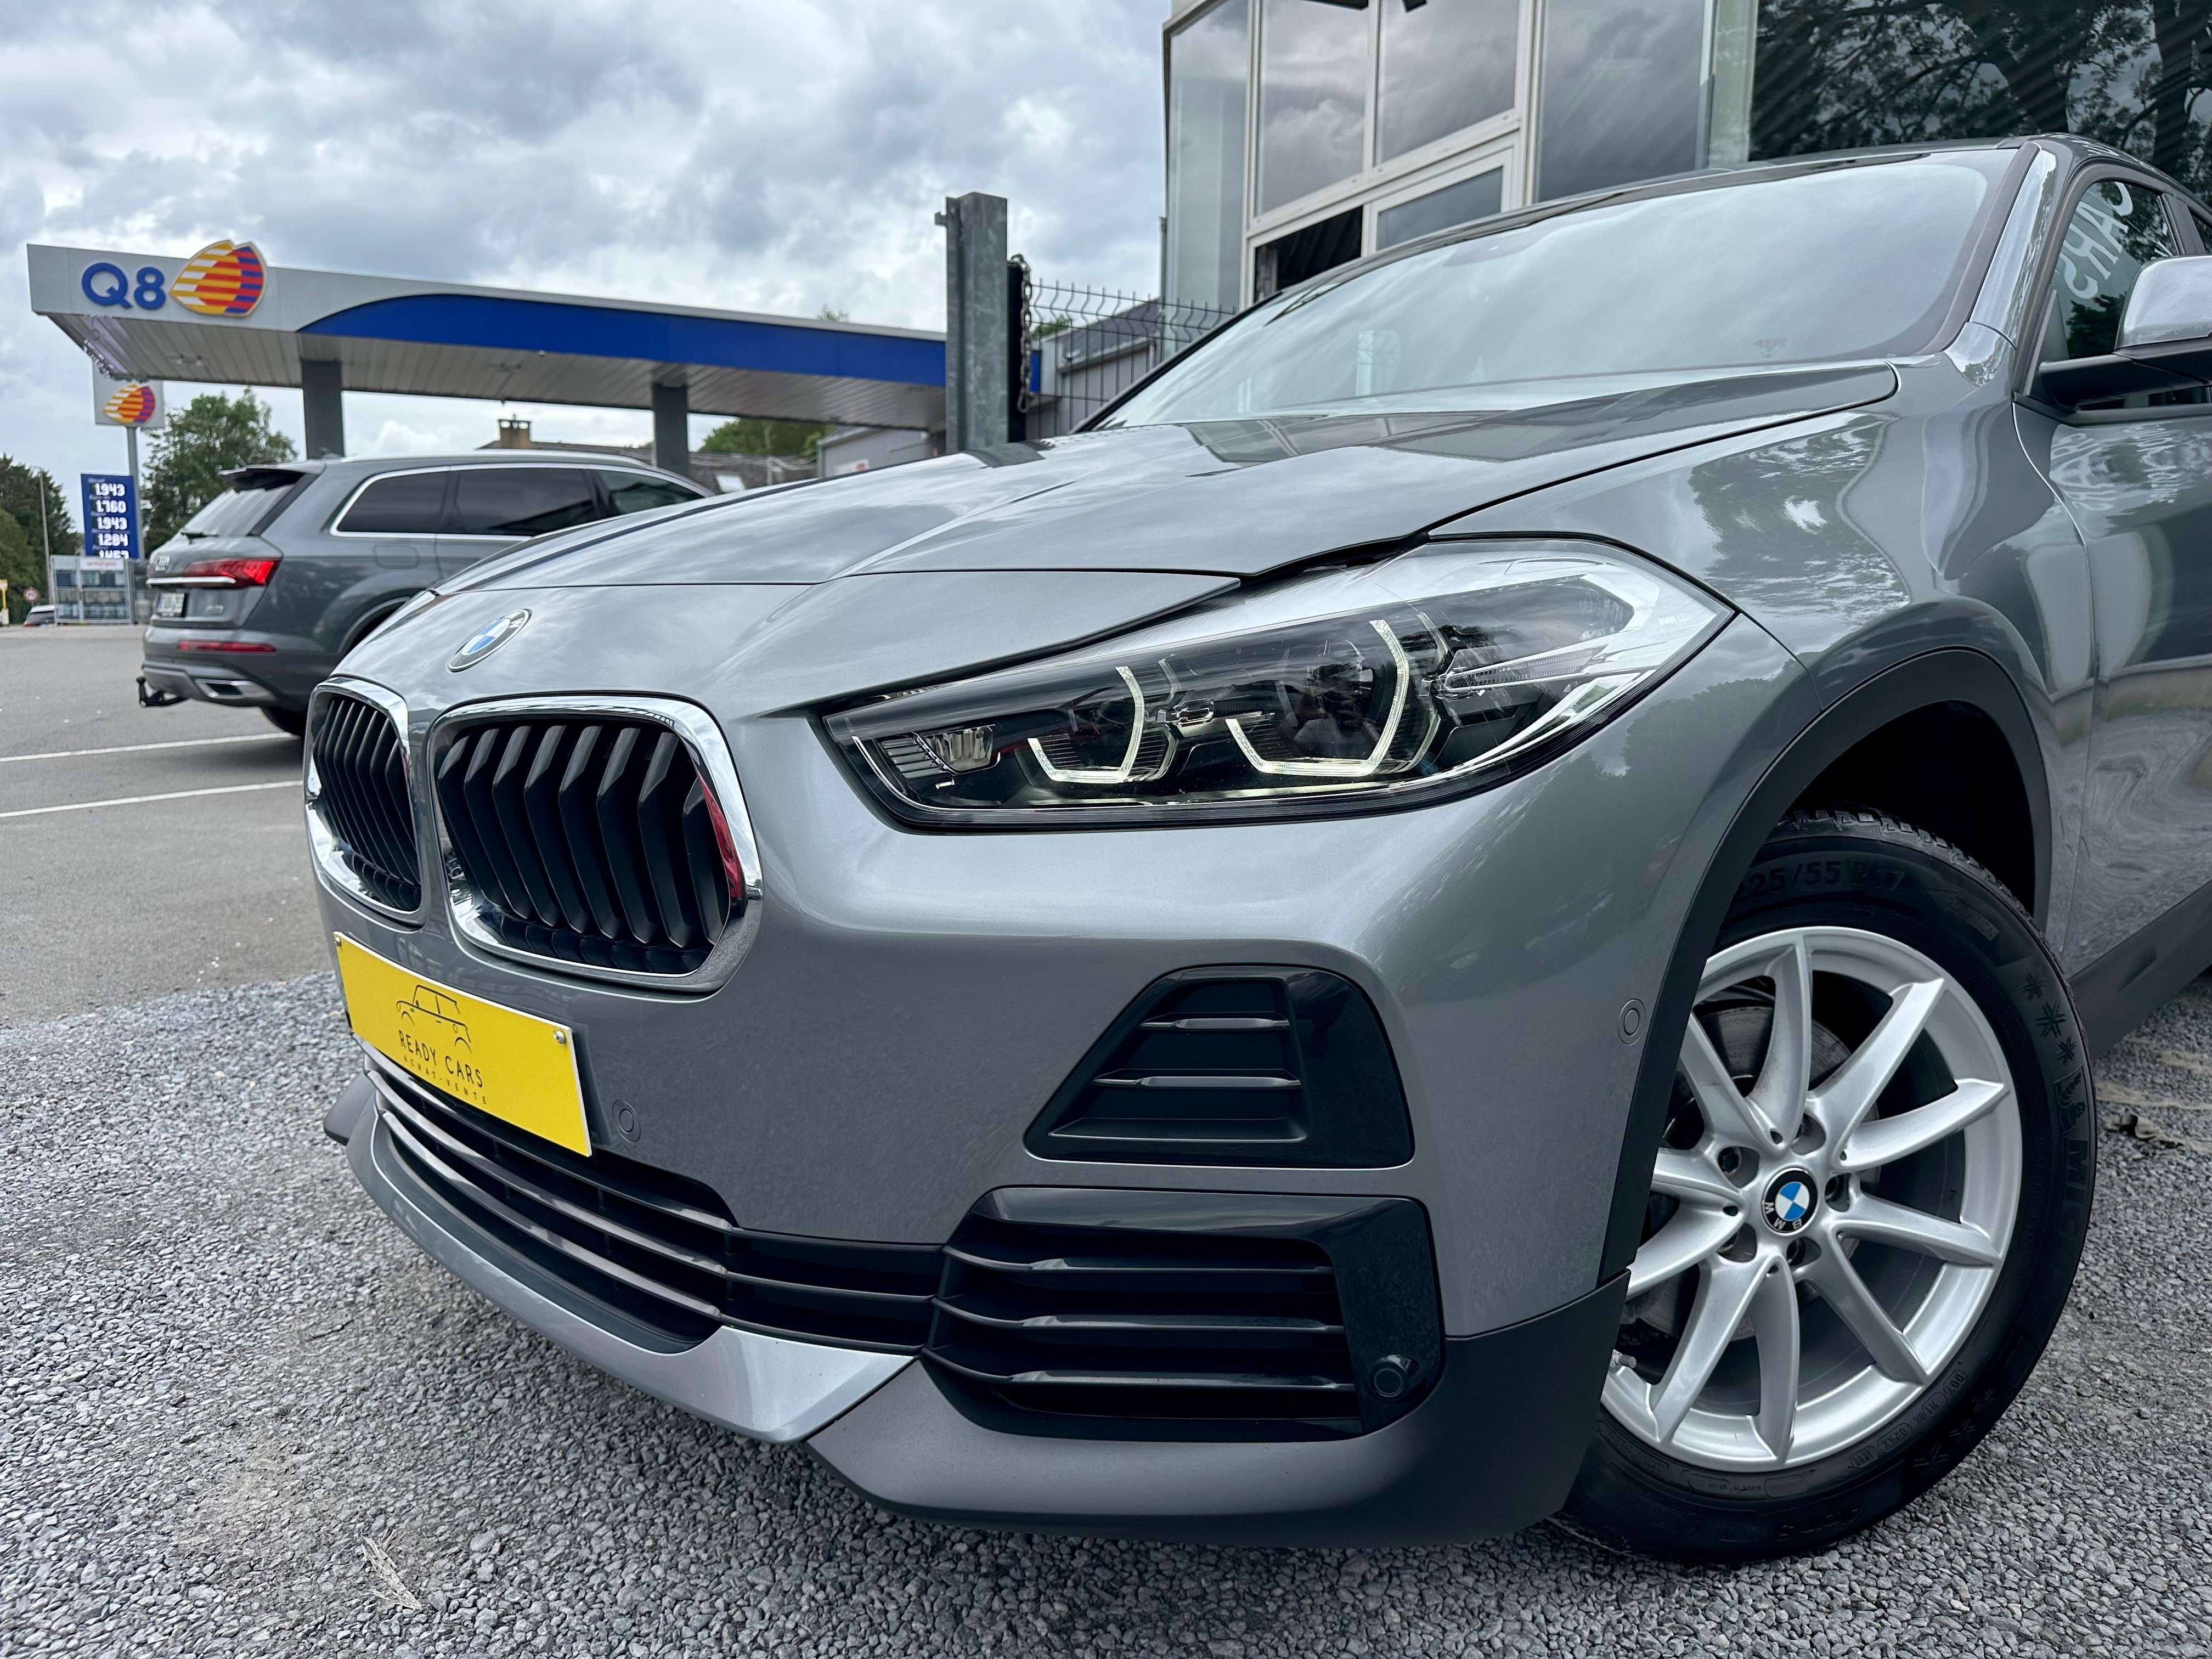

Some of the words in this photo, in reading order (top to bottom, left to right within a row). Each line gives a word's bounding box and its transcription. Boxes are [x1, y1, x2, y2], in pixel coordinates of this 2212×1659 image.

[81, 262, 166, 311] Q8
[1733, 861, 1841, 904] 25/55
[399, 1029, 437, 1066] READY
[445, 1055, 483, 1088] CARS
[404, 1054, 487, 1104] ACHAT-VENTE
[1764, 1201, 1803, 1230] BMW
[1947, 1373, 1965, 1394] DOT
